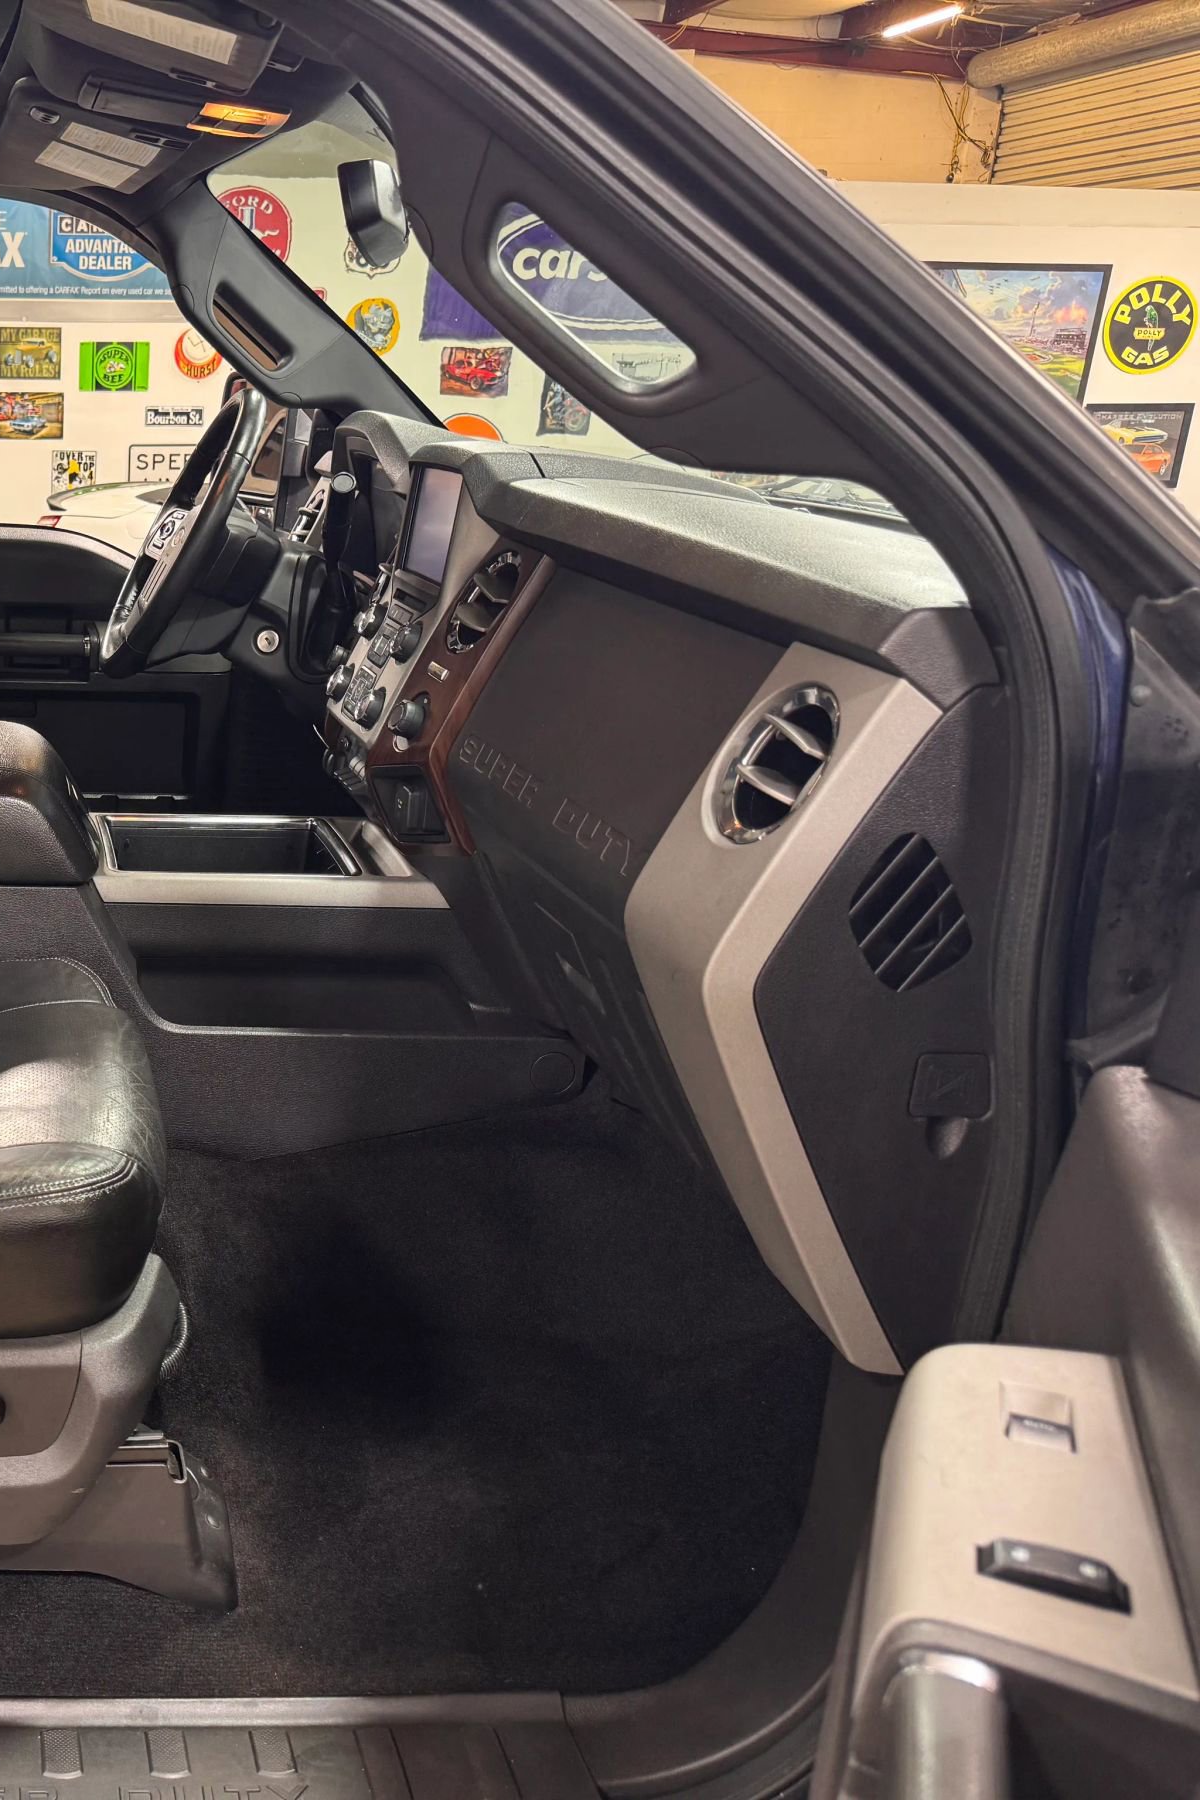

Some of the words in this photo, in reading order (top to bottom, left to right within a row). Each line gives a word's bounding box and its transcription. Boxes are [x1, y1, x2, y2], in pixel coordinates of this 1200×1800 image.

[79, 255, 132, 271] DEALER
[19, 286, 25, 294] to
[26, 286, 48, 296] offering
[81, 286, 100, 296] Report
[102, 287, 109, 295] on
[111, 287, 127, 297] every
[128, 286, 142, 295] used
[1114, 283, 1191, 326] POLLY
[1, 328, 17, 342] MY
[19, 328, 60, 342] GARAGE
[100, 349, 130, 363] SUPER
[1121, 346, 1170, 366] GAS
[1, 364, 18, 377] MY
[185, 358, 217, 378] HURST
[103, 373, 125, 383] BEE
[147, 411, 187, 425] Bourbon
[188, 411, 203, 425] St.
[59, 452, 84, 461] OVER
[78, 462, 95, 472] TOP
[459, 736, 542, 809] SUPER
[552, 798, 634, 877] DUTY
